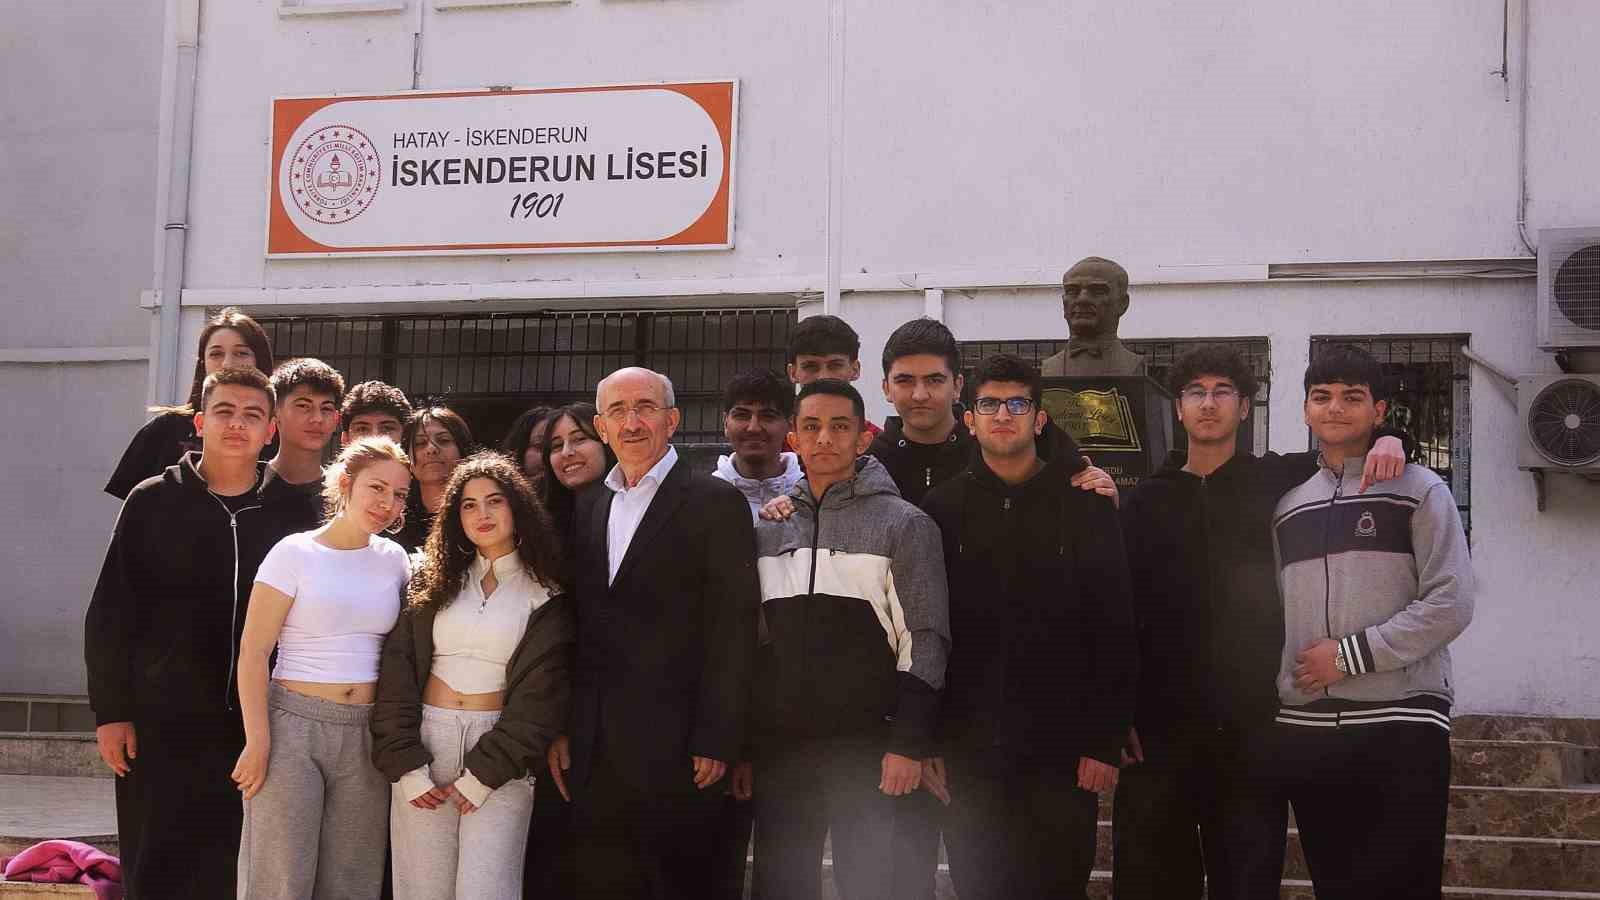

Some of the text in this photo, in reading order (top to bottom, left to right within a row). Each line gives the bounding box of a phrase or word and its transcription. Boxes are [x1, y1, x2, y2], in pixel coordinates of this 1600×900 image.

[393, 131, 450, 149] HATAY
[466, 125, 588, 147] İSKENDERUN
[391, 145, 708, 187] İSKENDERUN LİSESİ
[510, 191, 564, 219] 1901
